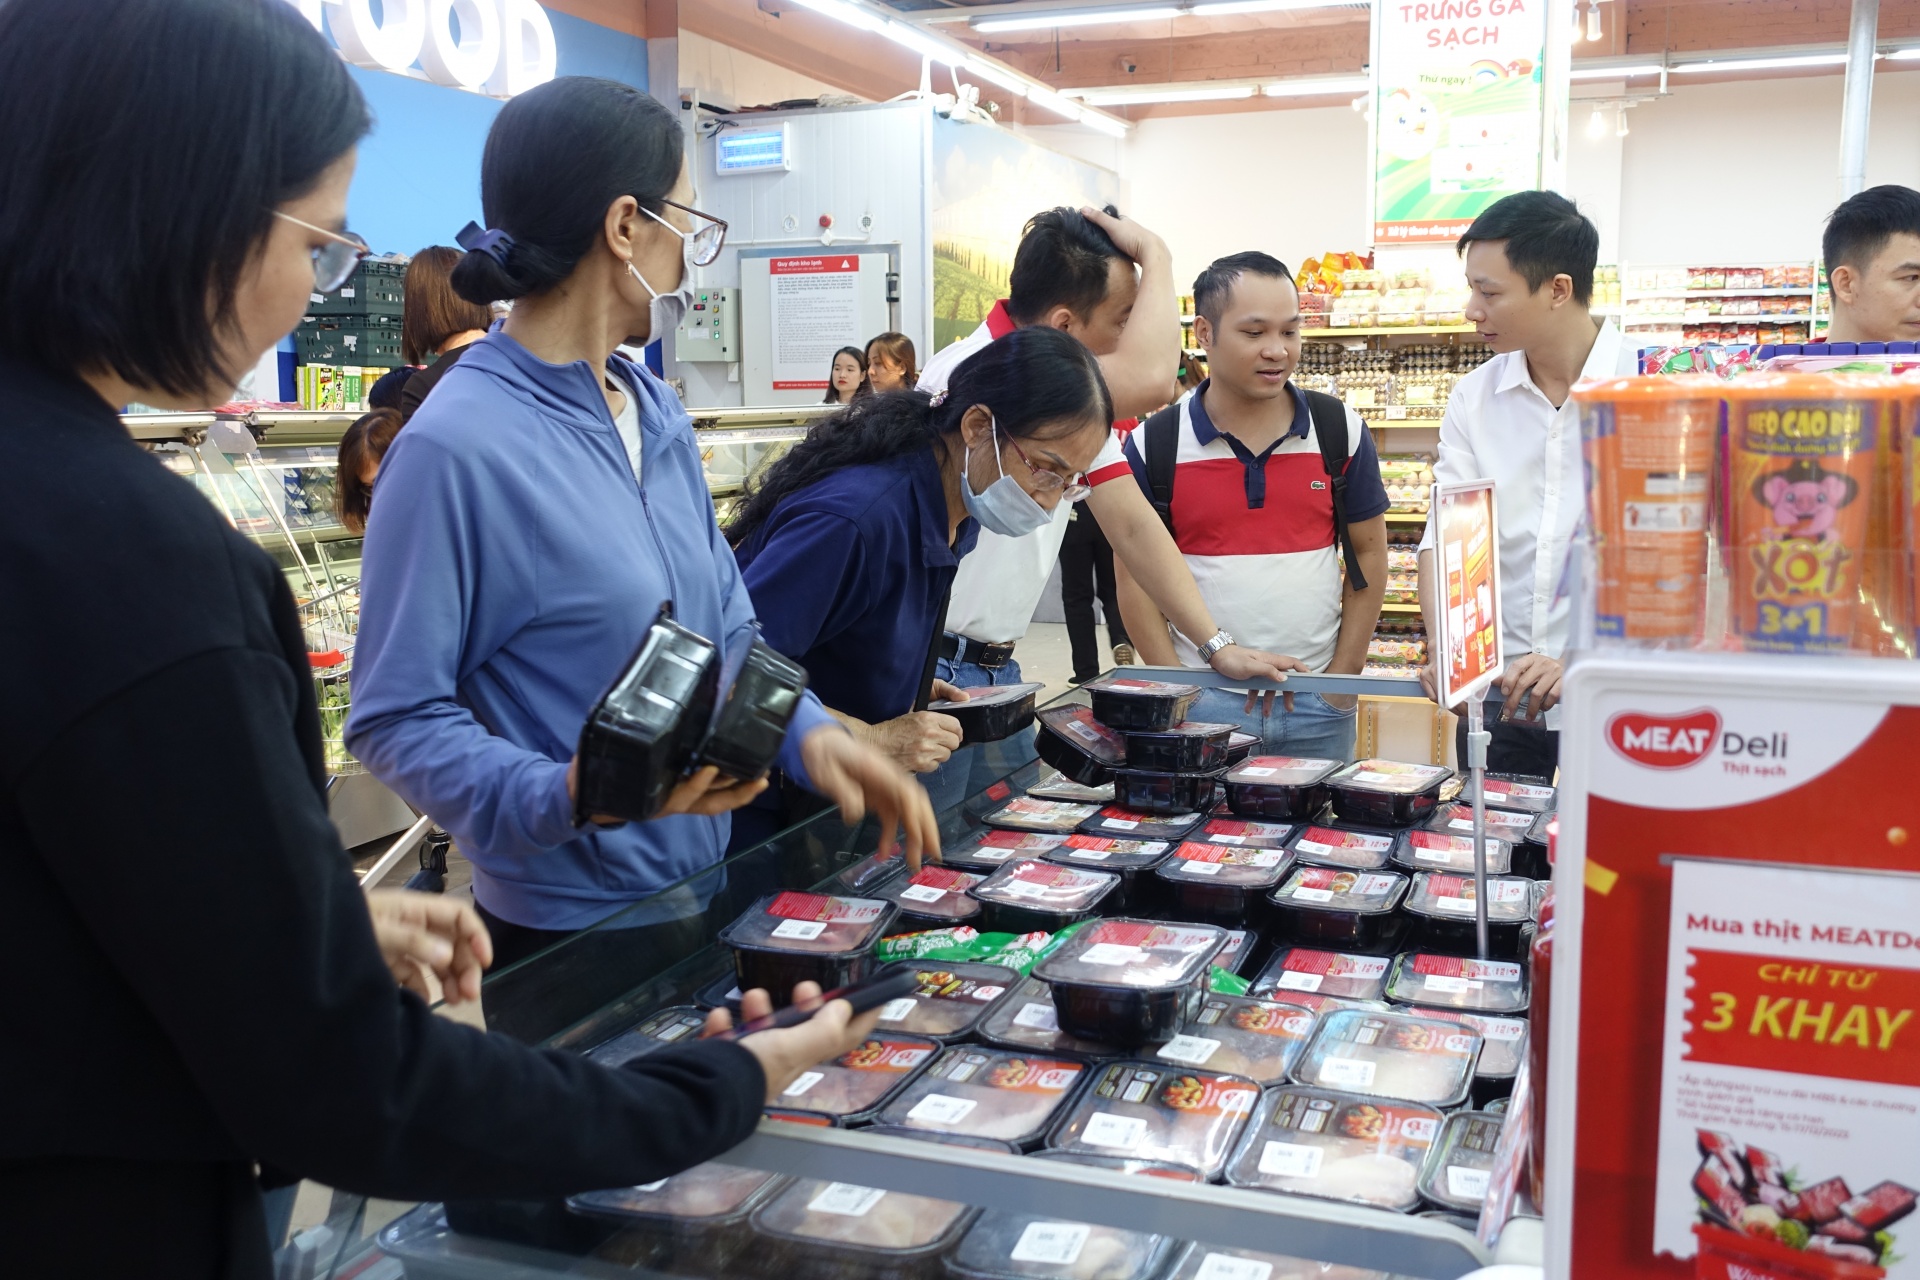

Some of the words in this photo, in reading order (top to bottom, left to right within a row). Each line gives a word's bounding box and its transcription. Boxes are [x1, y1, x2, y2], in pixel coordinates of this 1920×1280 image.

[300, 0, 557, 98] OOD
[1427, 26, 1499, 51] SẠCH
[1440, 76, 1466, 86] ngay
[777, 260, 788, 268] Quy
[1760, 603, 1822, 637] 3+1
[1622, 725, 1710, 755] MEAT
[1722, 731, 1788, 759] Deli
[1722, 761, 1750, 776] Thịt
[1754, 763, 1787, 778] sạch
[1686, 913, 1744, 935] Mua
[1753, 918, 1802, 944] thịt
[1758, 963, 1821, 986] CHỈ
[1825, 967, 1878, 991] TỪ
[1701, 991, 1738, 1032] 3
[1748, 995, 1914, 1051] KHAY
